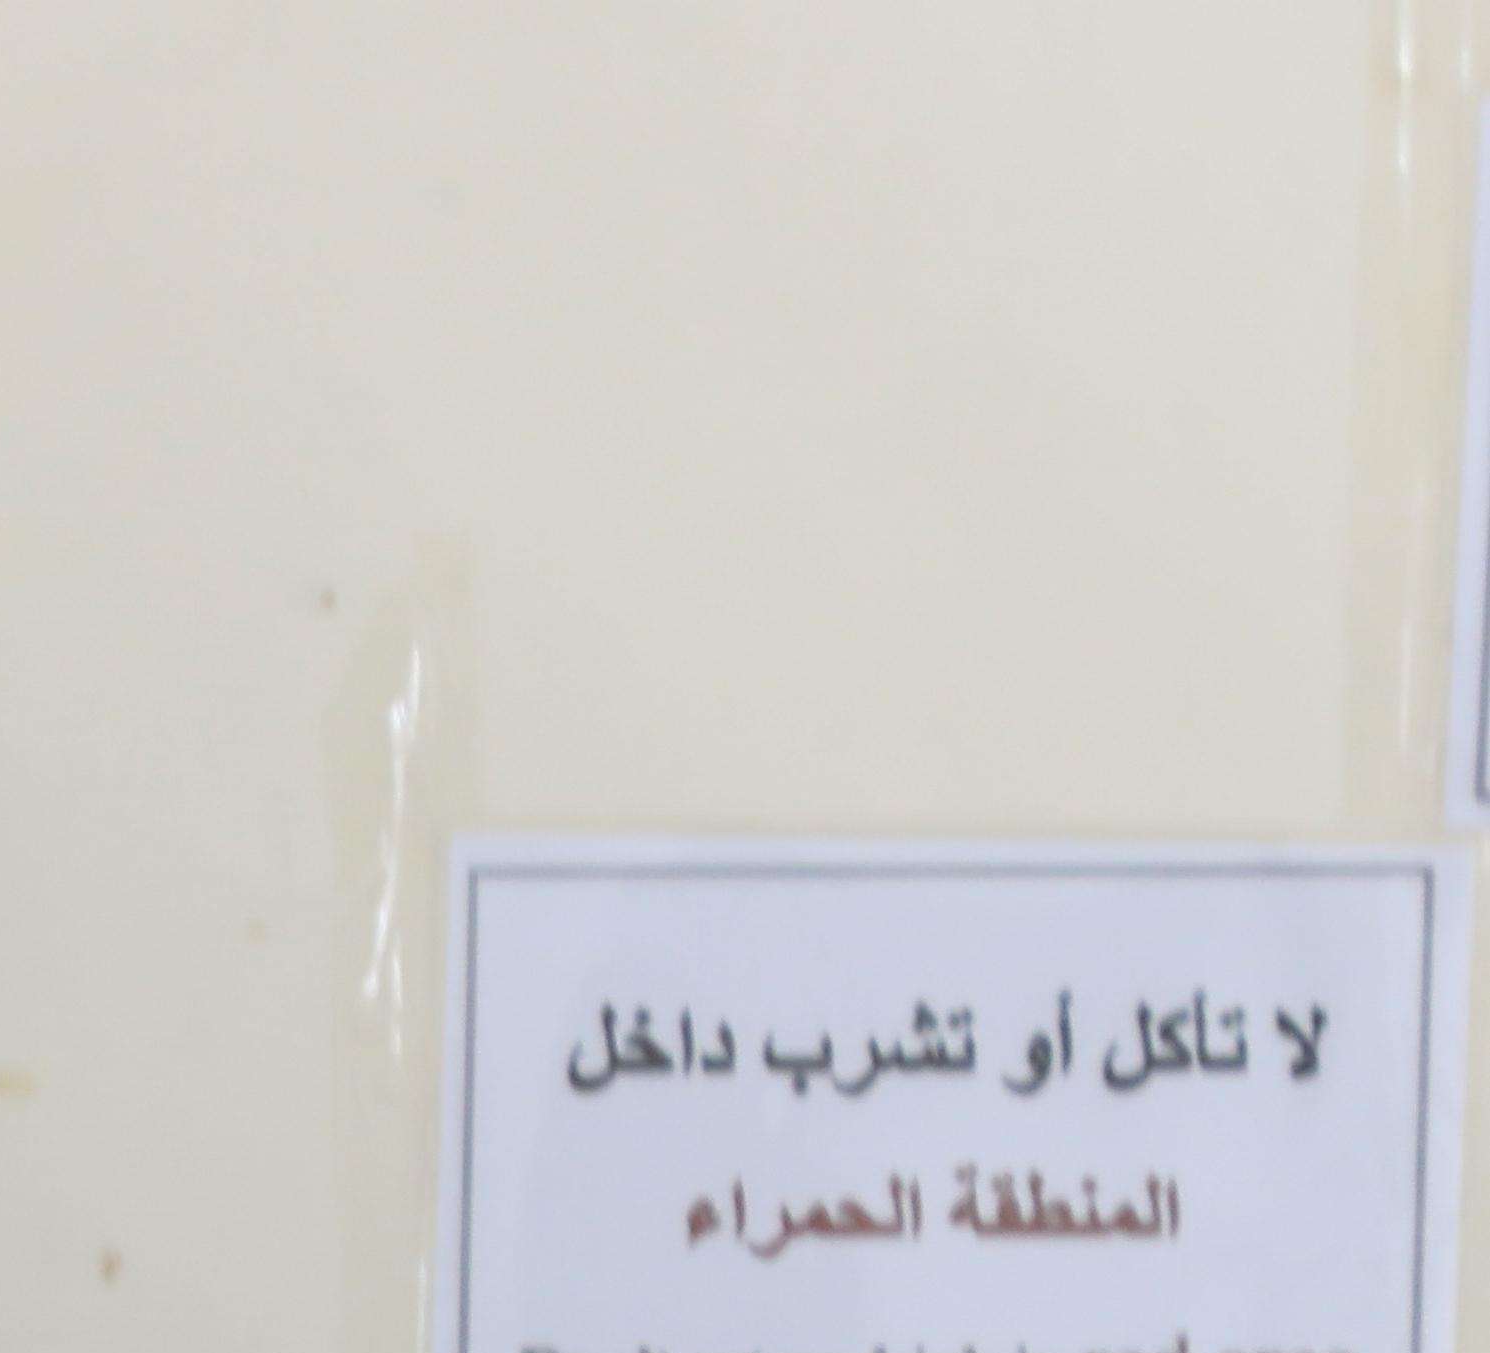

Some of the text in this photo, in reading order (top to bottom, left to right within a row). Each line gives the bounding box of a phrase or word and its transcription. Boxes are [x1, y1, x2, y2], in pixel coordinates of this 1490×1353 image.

[564, 988, 1330, 1098] لا تأكل أو تشرب داخل
[684, 1162, 1180, 1260] المنطقة الحمراء
